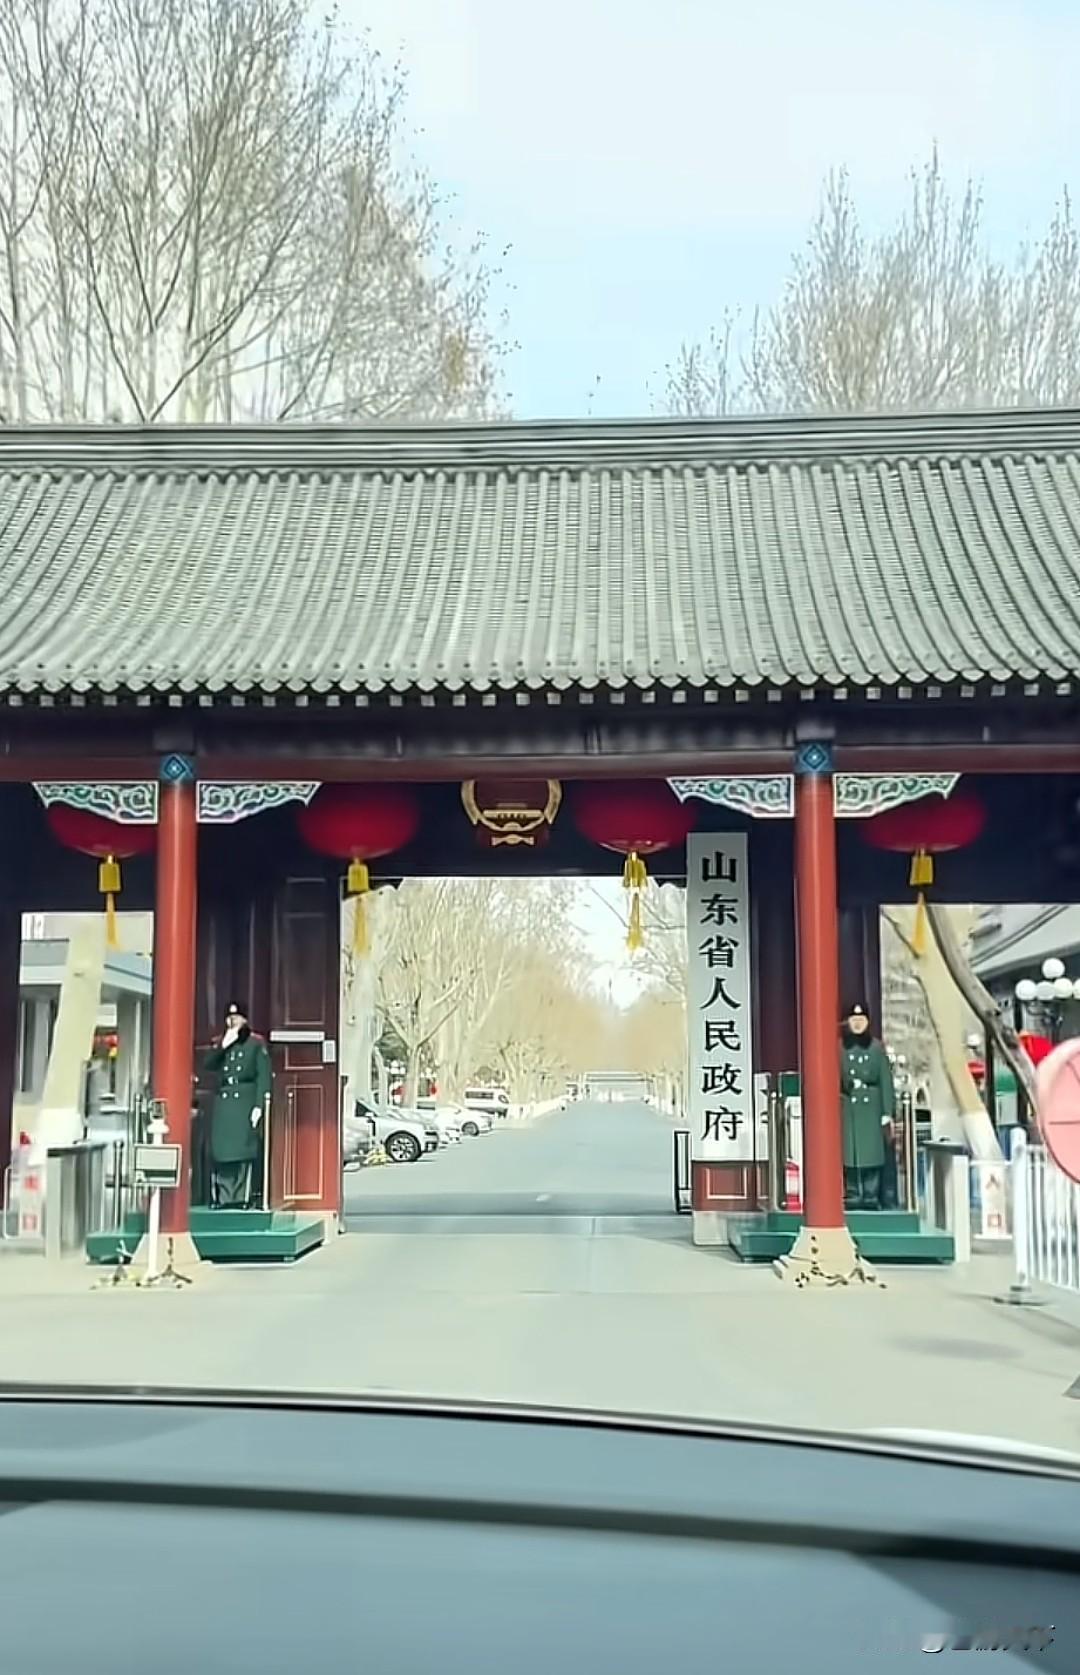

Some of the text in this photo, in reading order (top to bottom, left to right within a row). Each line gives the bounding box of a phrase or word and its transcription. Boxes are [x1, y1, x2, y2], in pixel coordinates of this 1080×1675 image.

[698, 851, 743, 1141] 山东省人民政府
